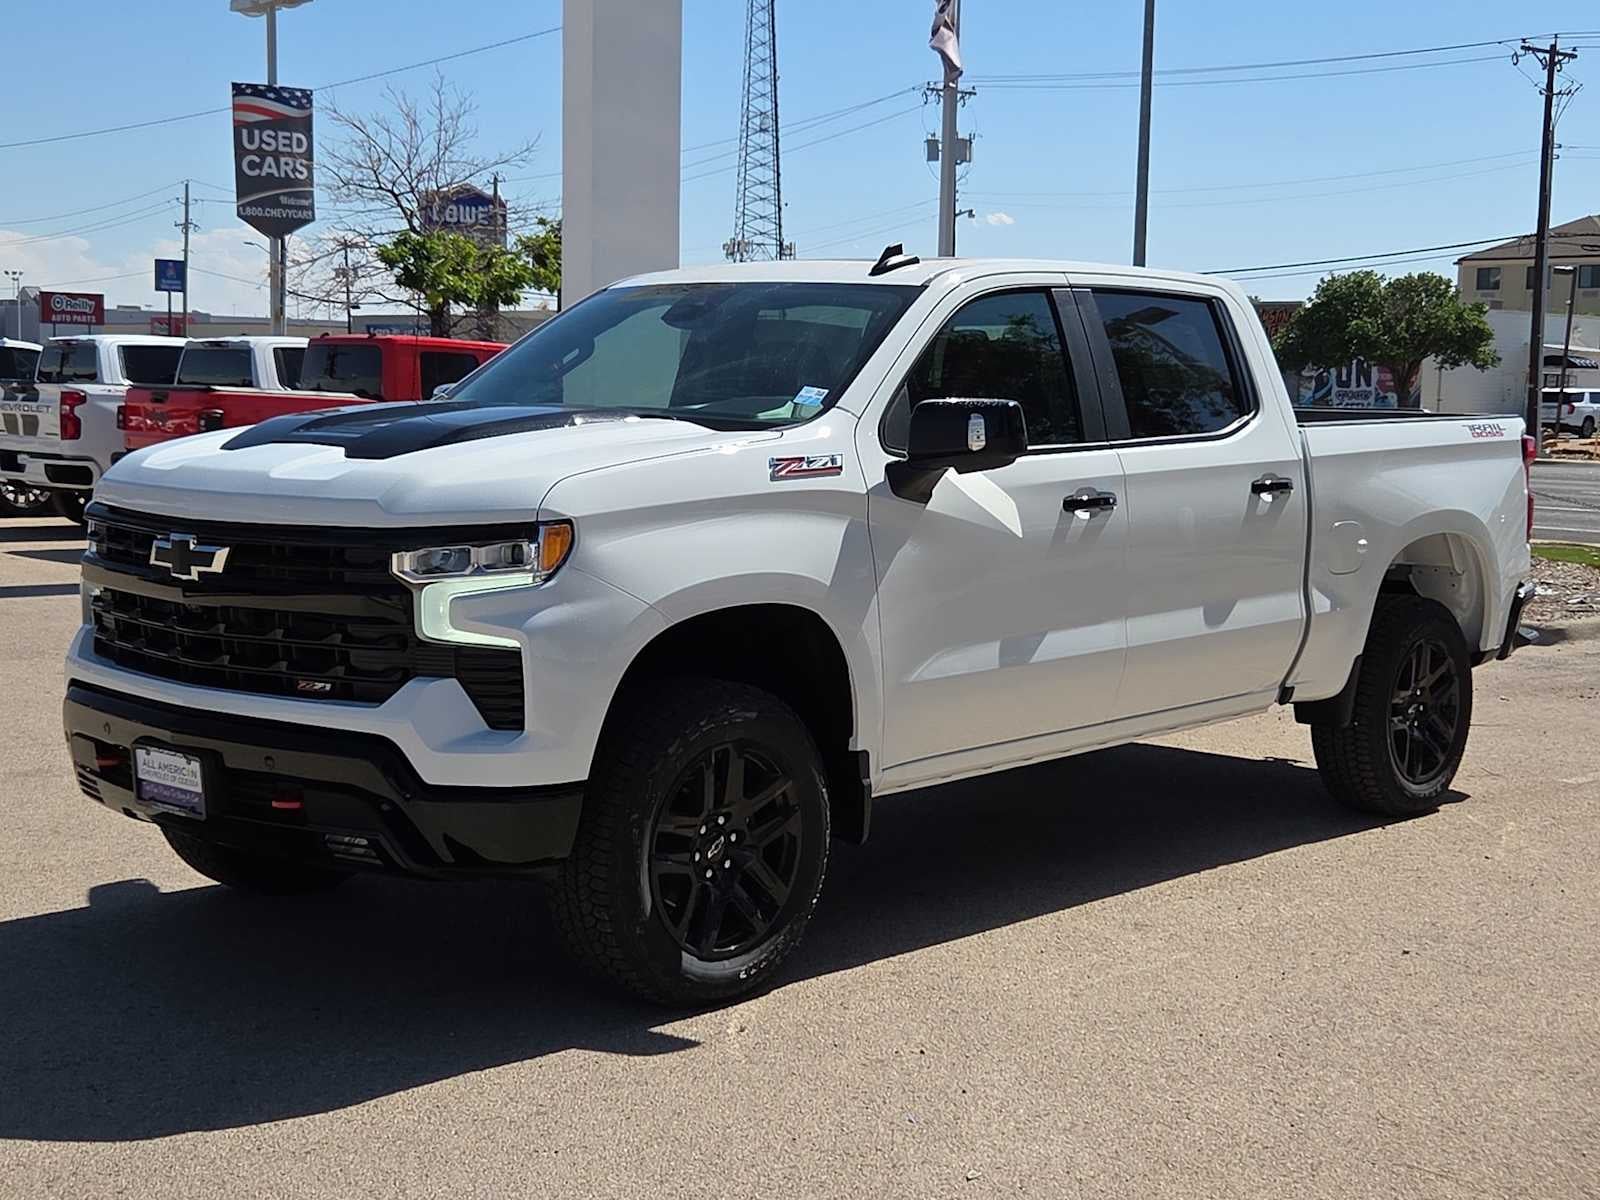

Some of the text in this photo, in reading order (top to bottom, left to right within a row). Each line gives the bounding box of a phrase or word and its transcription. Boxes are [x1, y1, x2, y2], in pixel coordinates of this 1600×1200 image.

[241, 129, 308, 153] USED
[241, 155, 308, 180] CARS
[52, 294, 95, 313] O'Reilly
[52, 314, 96, 323] AUTO PARTS
[1462, 424, 1507, 432] TRAIL
[769, 454, 843, 480] Z71
[297, 680, 332, 691] Z71
[143, 758, 156, 769] ALL
